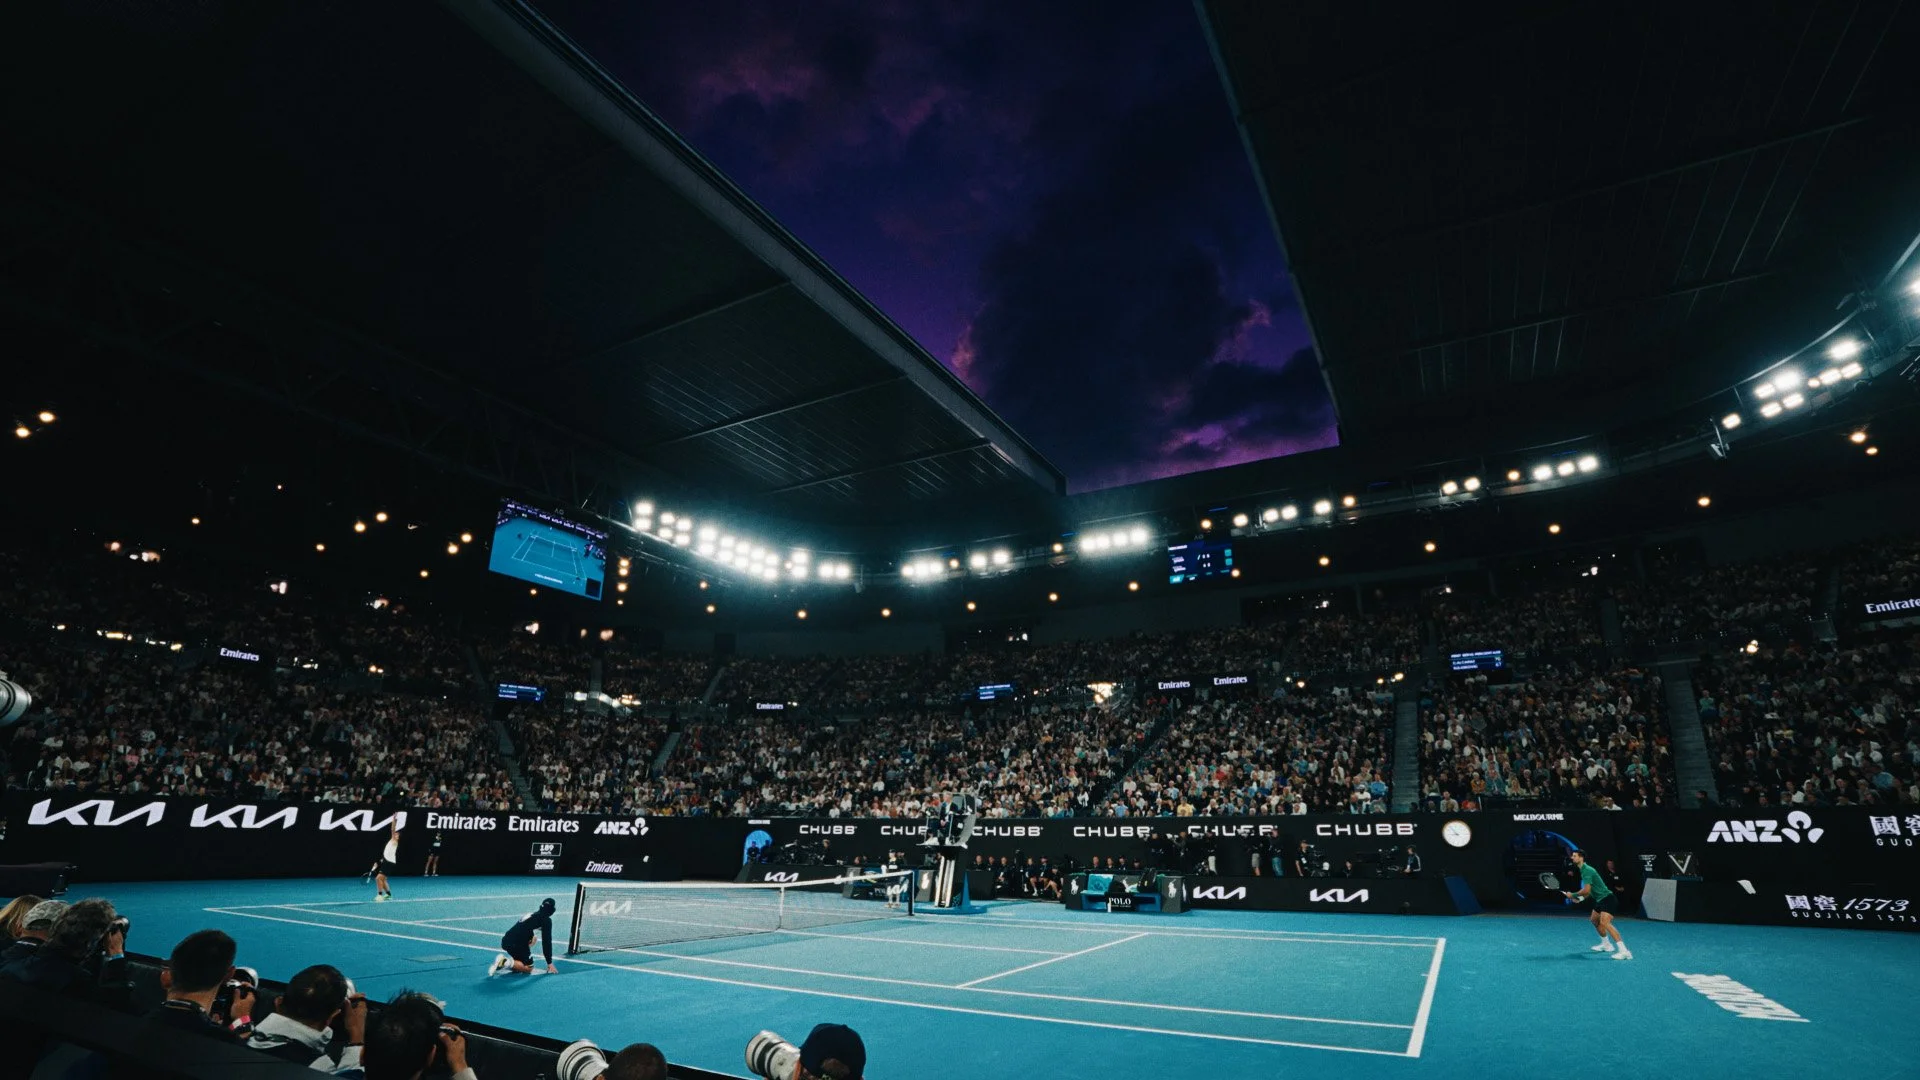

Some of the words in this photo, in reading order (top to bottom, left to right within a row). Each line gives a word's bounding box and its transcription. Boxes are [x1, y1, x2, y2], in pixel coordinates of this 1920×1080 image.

[1865, 599, 1920, 613] Emirate
[220, 648, 259, 661] Emirates
[1158, 681, 1190, 689] Emirates
[1214, 677, 1247, 685] Emirates
[427, 812, 496, 830] Emirates
[508, 815, 579, 832] Emirates
[594, 822, 630, 835] ANZ
[800, 825, 855, 835] CHUBB
[972, 826, 1041, 837] CHUBB
[1317, 824, 1414, 836] CHUBB
[1707, 820, 1783, 842] ANZ
[585, 861, 623, 873] Emirates
[1109, 897, 1132, 905] POLO
[1843, 898, 1910, 912] 1573
[1791, 911, 1863, 920] GUOJIAO
